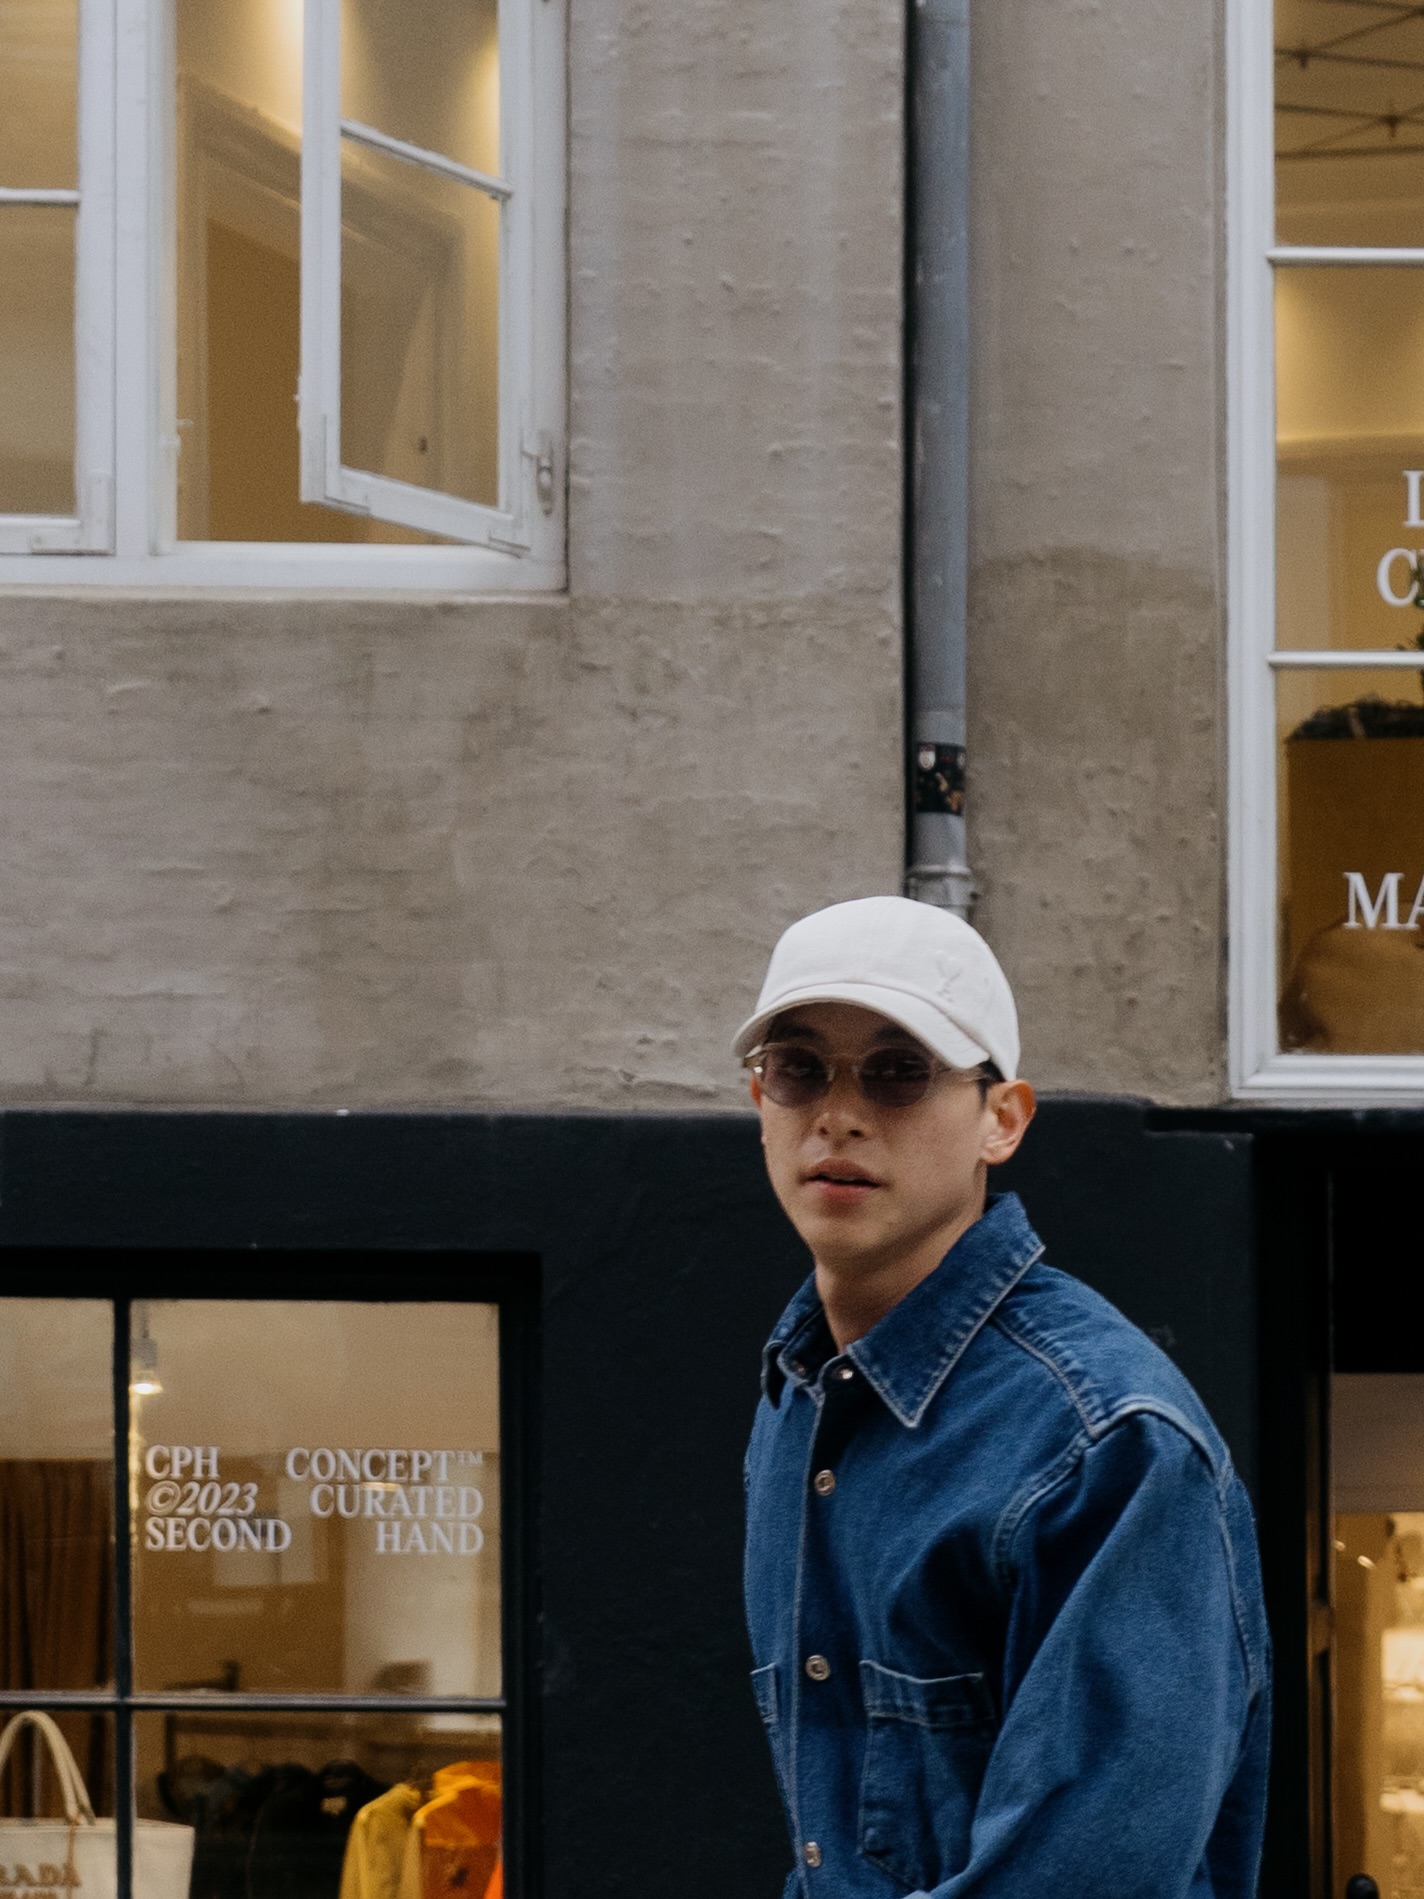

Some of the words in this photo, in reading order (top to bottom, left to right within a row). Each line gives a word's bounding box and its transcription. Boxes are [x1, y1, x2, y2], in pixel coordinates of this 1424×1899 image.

[145, 1444, 221, 1480] CPH
[309, 1483, 485, 1519] CURATED
[144, 1517, 293, 1553] SECOND
[374, 1520, 485, 1556] HAND
